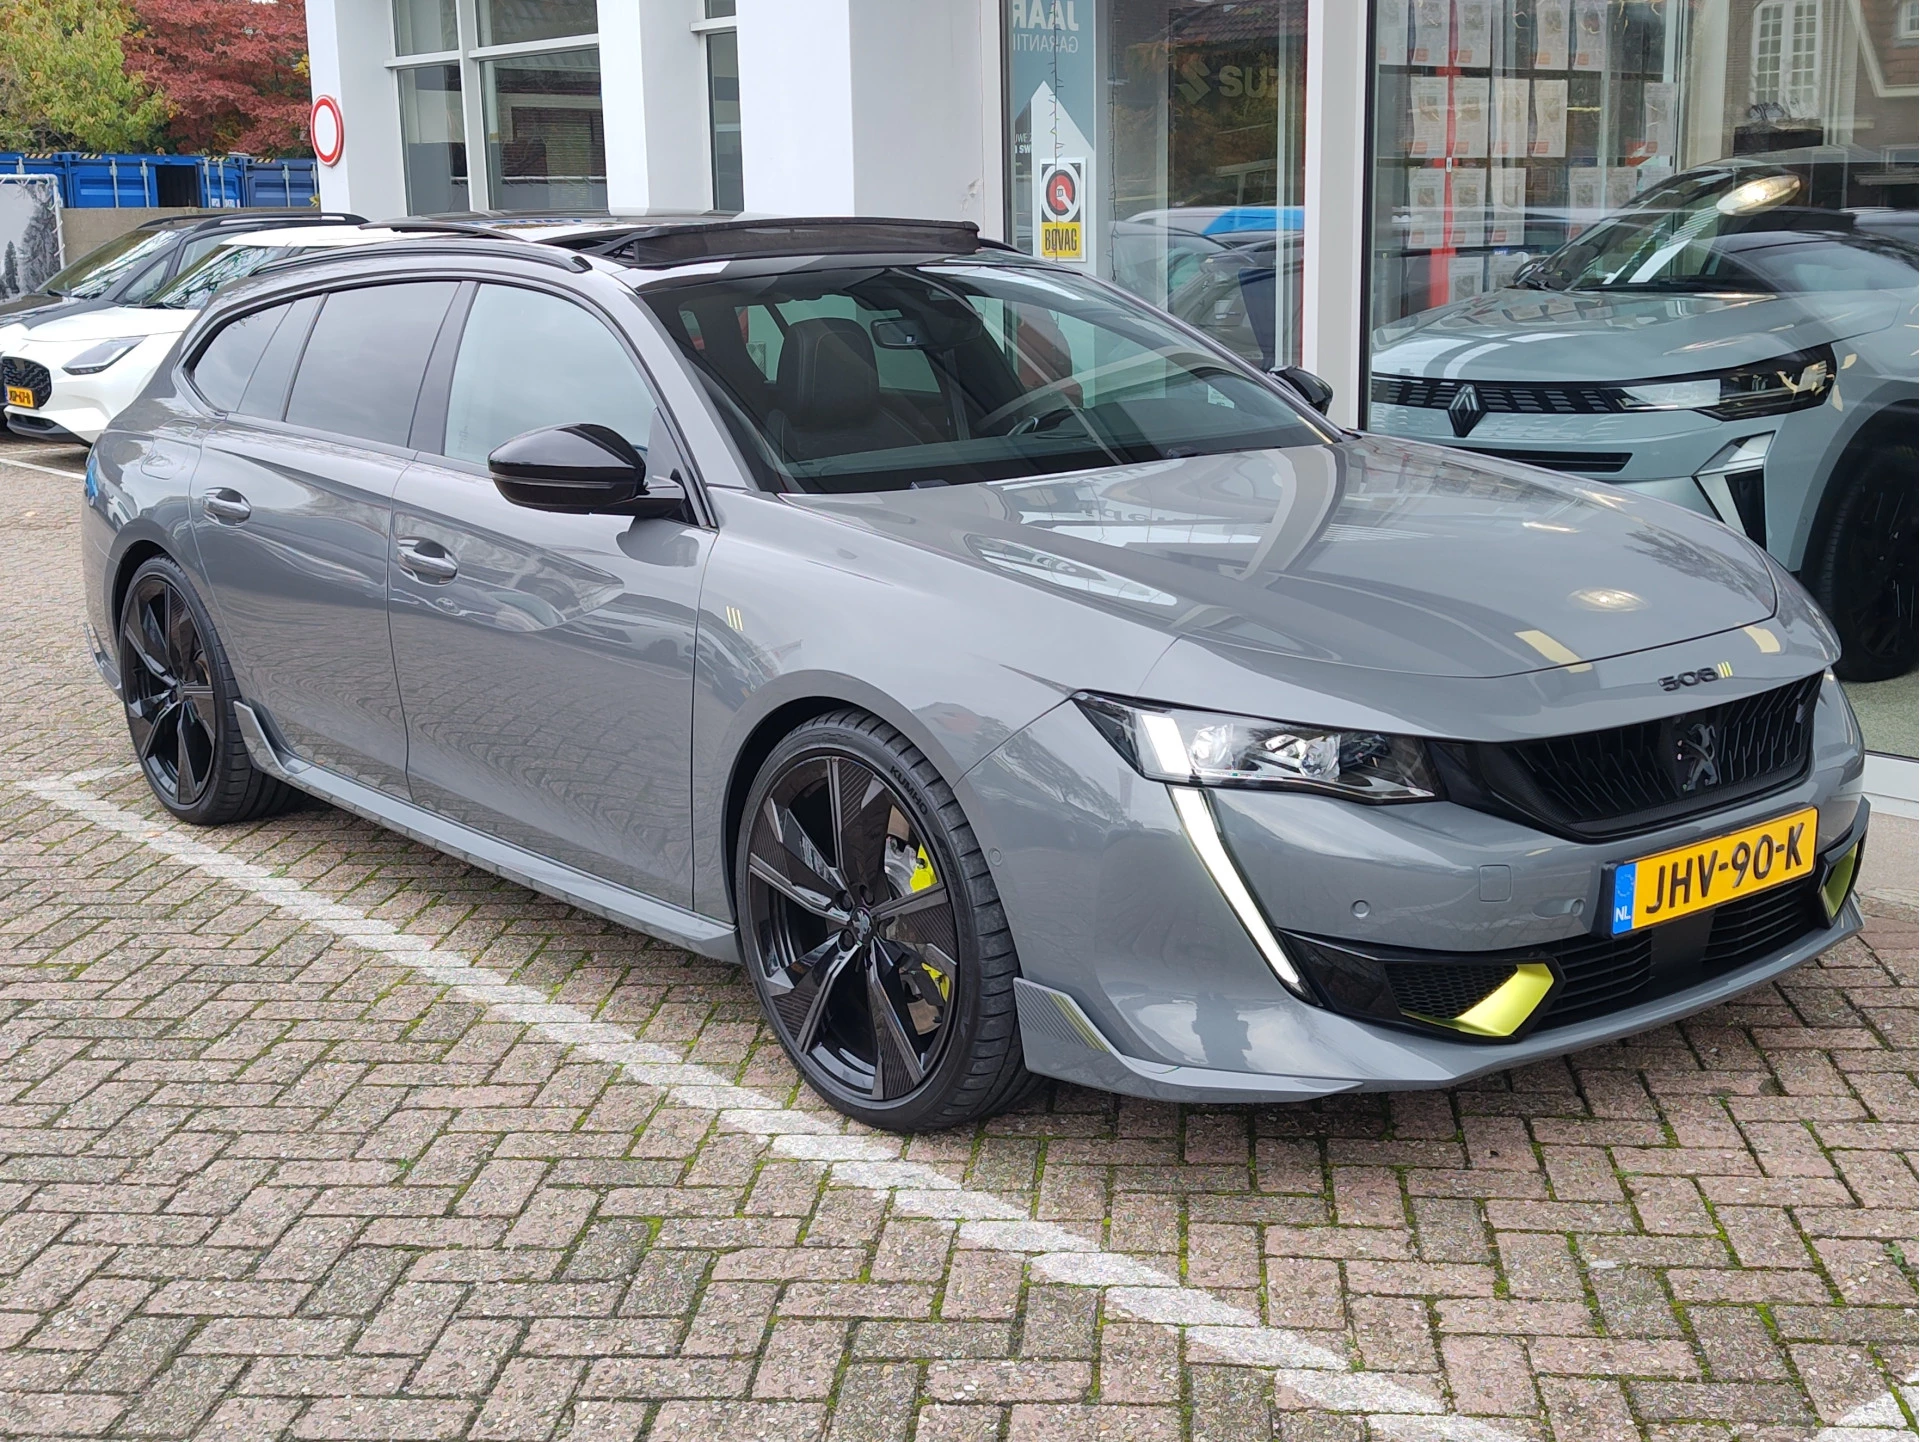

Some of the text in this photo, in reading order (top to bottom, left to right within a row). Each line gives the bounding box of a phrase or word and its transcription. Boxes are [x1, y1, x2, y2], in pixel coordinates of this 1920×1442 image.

[1045, 228, 1077, 251] BOVAG
[1658, 667, 1719, 692] 508
[889, 765, 928, 815] KUMHO
[1645, 822, 1805, 914] JHV-90-K
[1615, 906, 1631, 922] NL
